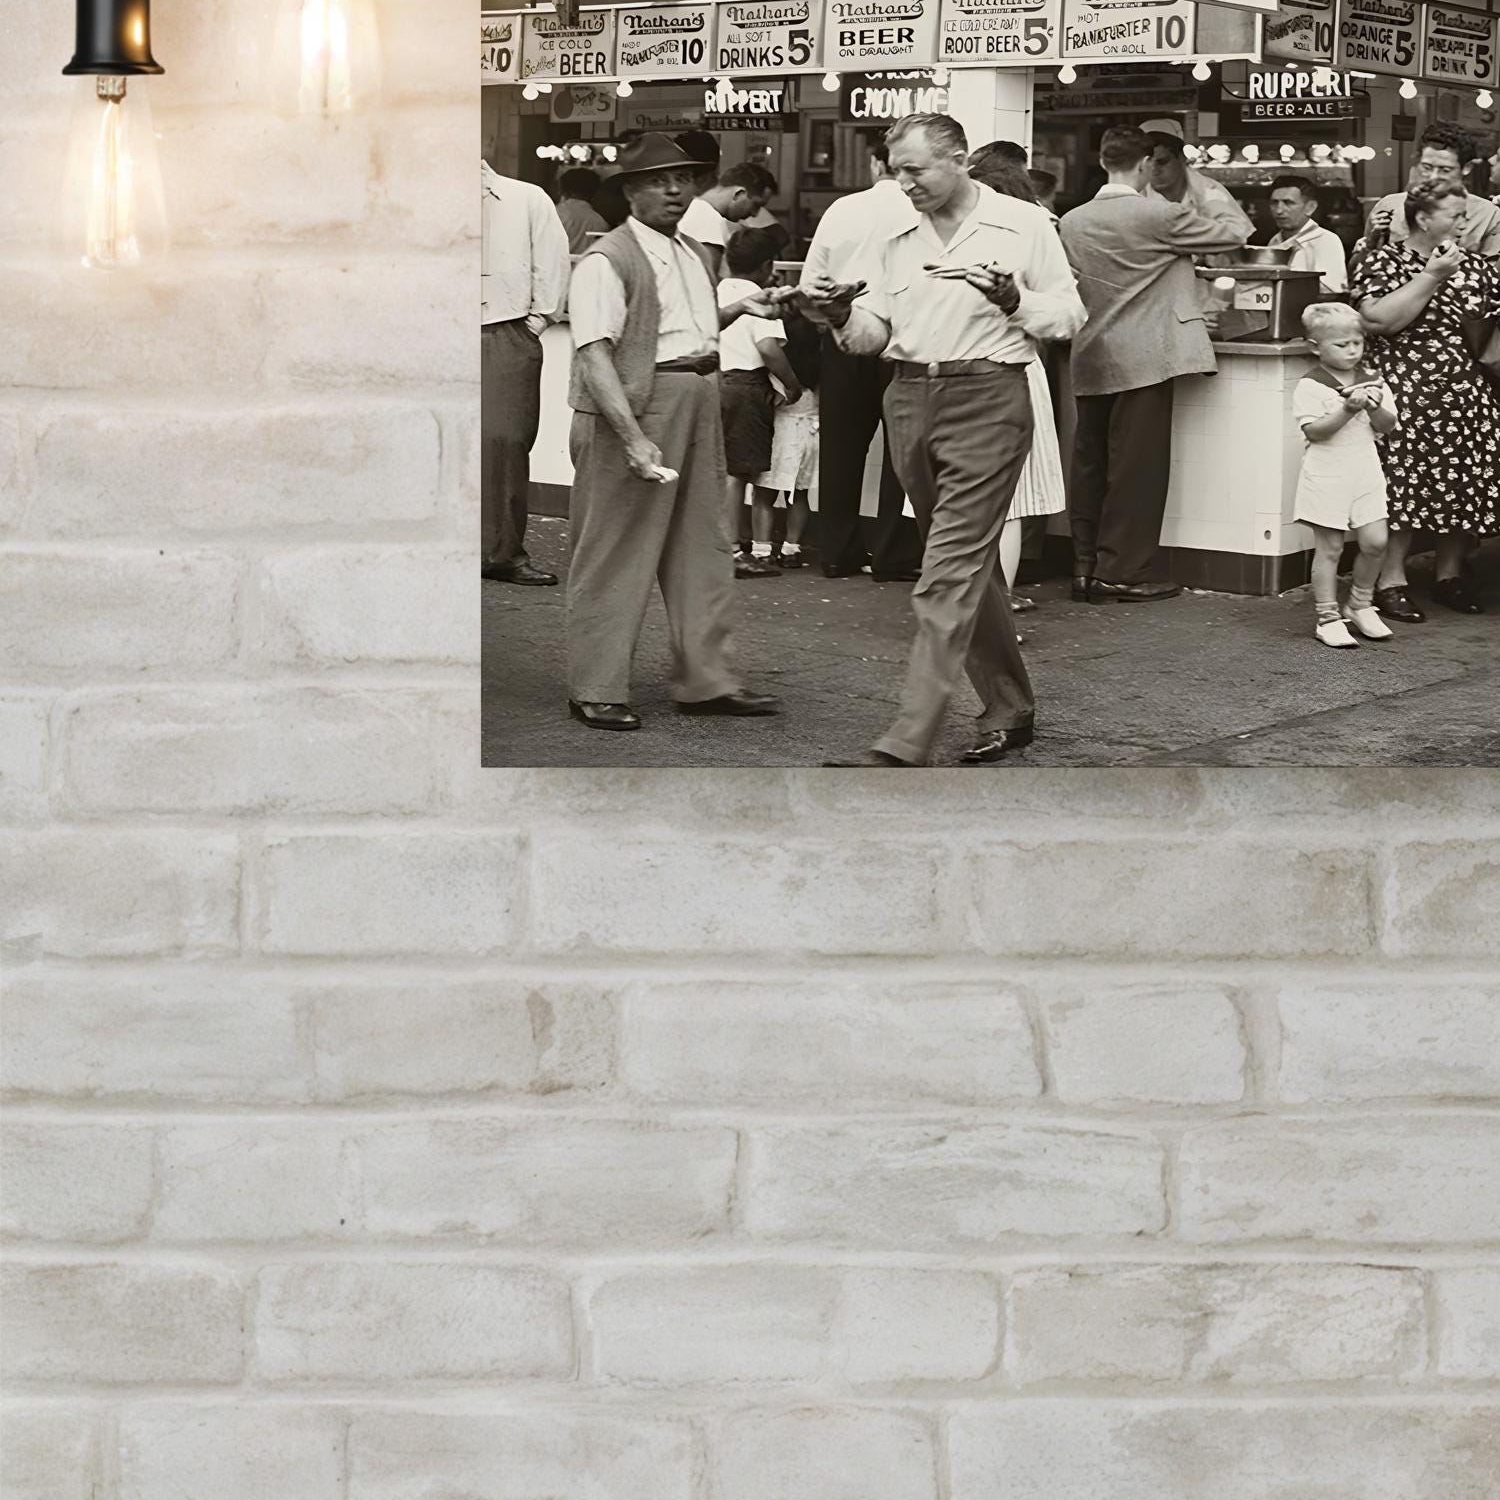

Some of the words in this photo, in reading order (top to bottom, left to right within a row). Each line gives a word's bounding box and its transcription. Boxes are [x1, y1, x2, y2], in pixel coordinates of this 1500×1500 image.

[727, 1, 810, 23] Nathan's
[832, 0, 925, 18] Nathan's
[623, 12, 705, 29] Nathan's
[839, 28, 915, 47] BEER
[1065, 18, 1151, 52] FRANKFURTER
[1340, 21, 1394, 46] ORANGE
[839, 48, 855, 58] ON
[945, 36, 982, 54] ROOT
[986, 35, 1021, 53] BEER
[1346, 42, 1390, 63] DRINK
[560, 51, 606, 76] BEER
[720, 46, 784, 69] DRINKS
